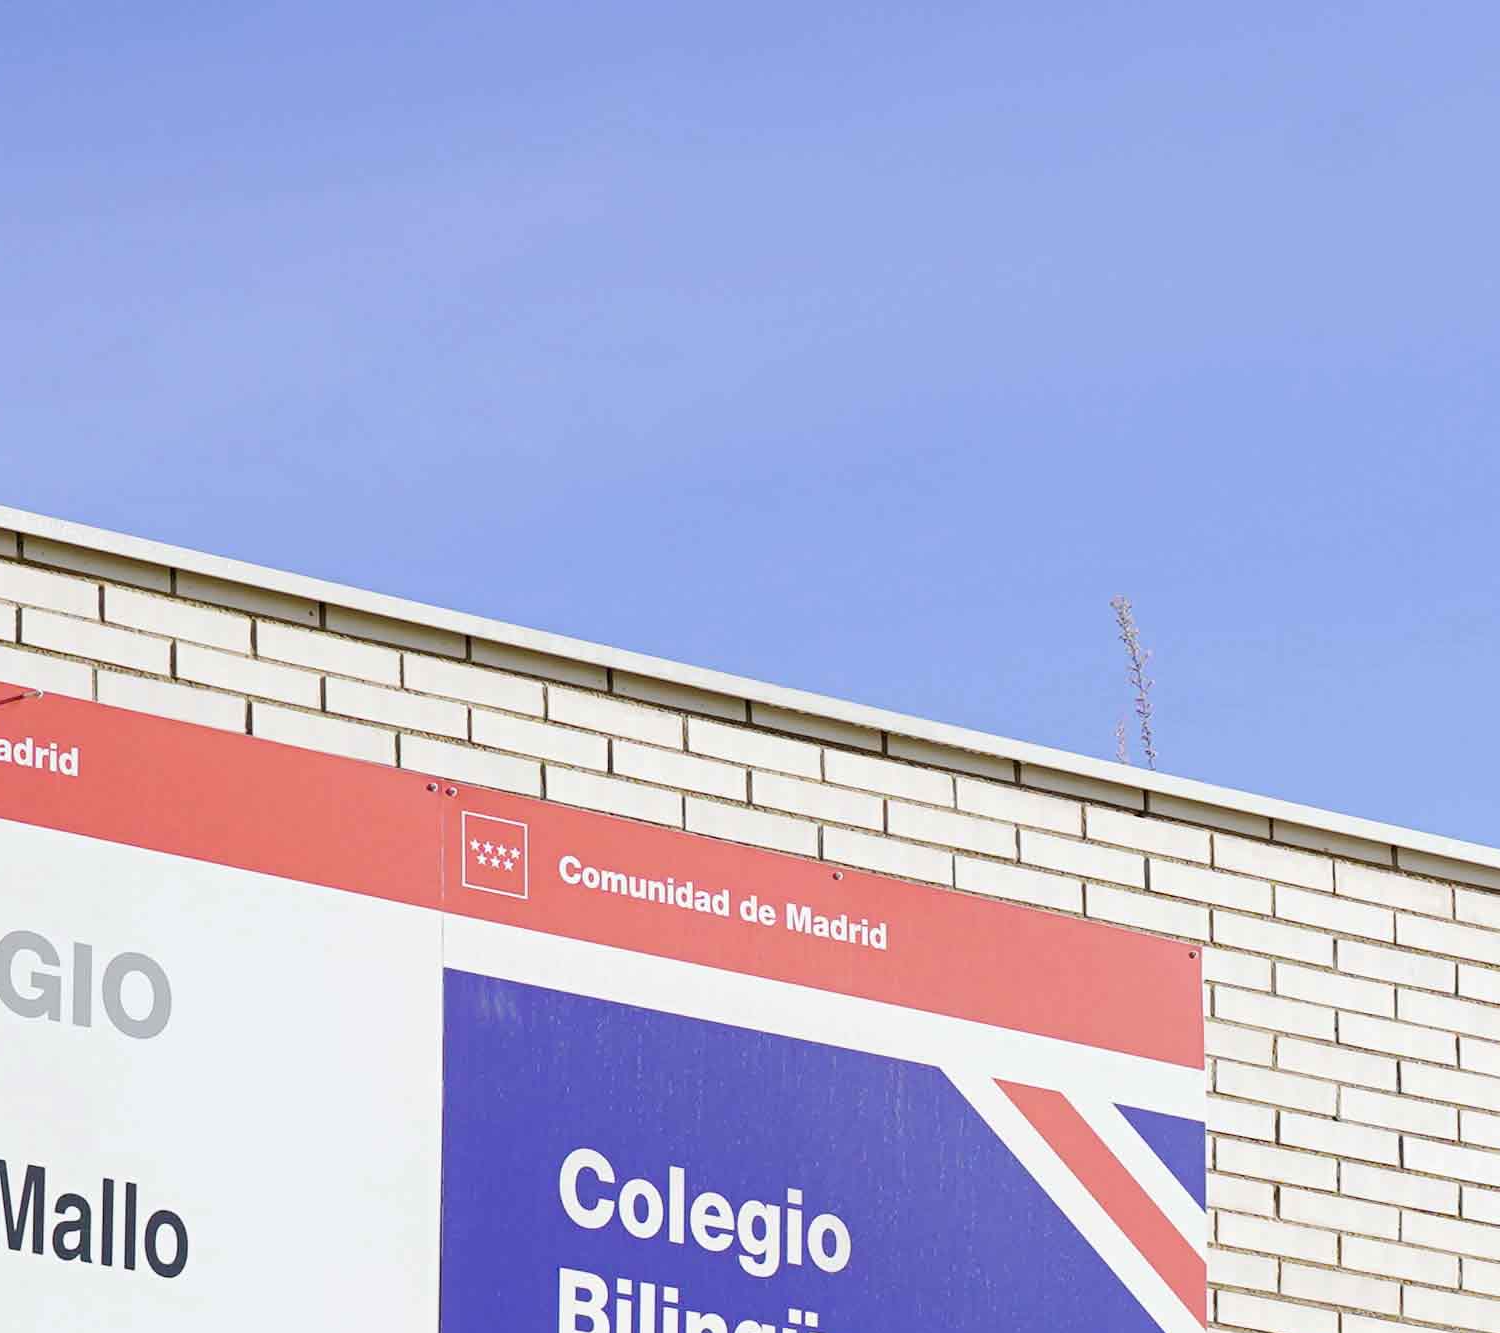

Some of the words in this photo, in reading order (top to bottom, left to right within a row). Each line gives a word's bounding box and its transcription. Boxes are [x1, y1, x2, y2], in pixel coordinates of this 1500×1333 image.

[559, 856, 731, 917] Comunidad
[739, 894, 777, 927] de
[786, 903, 888, 951] Madrid
[559, 1148, 851, 1279] Colegio
